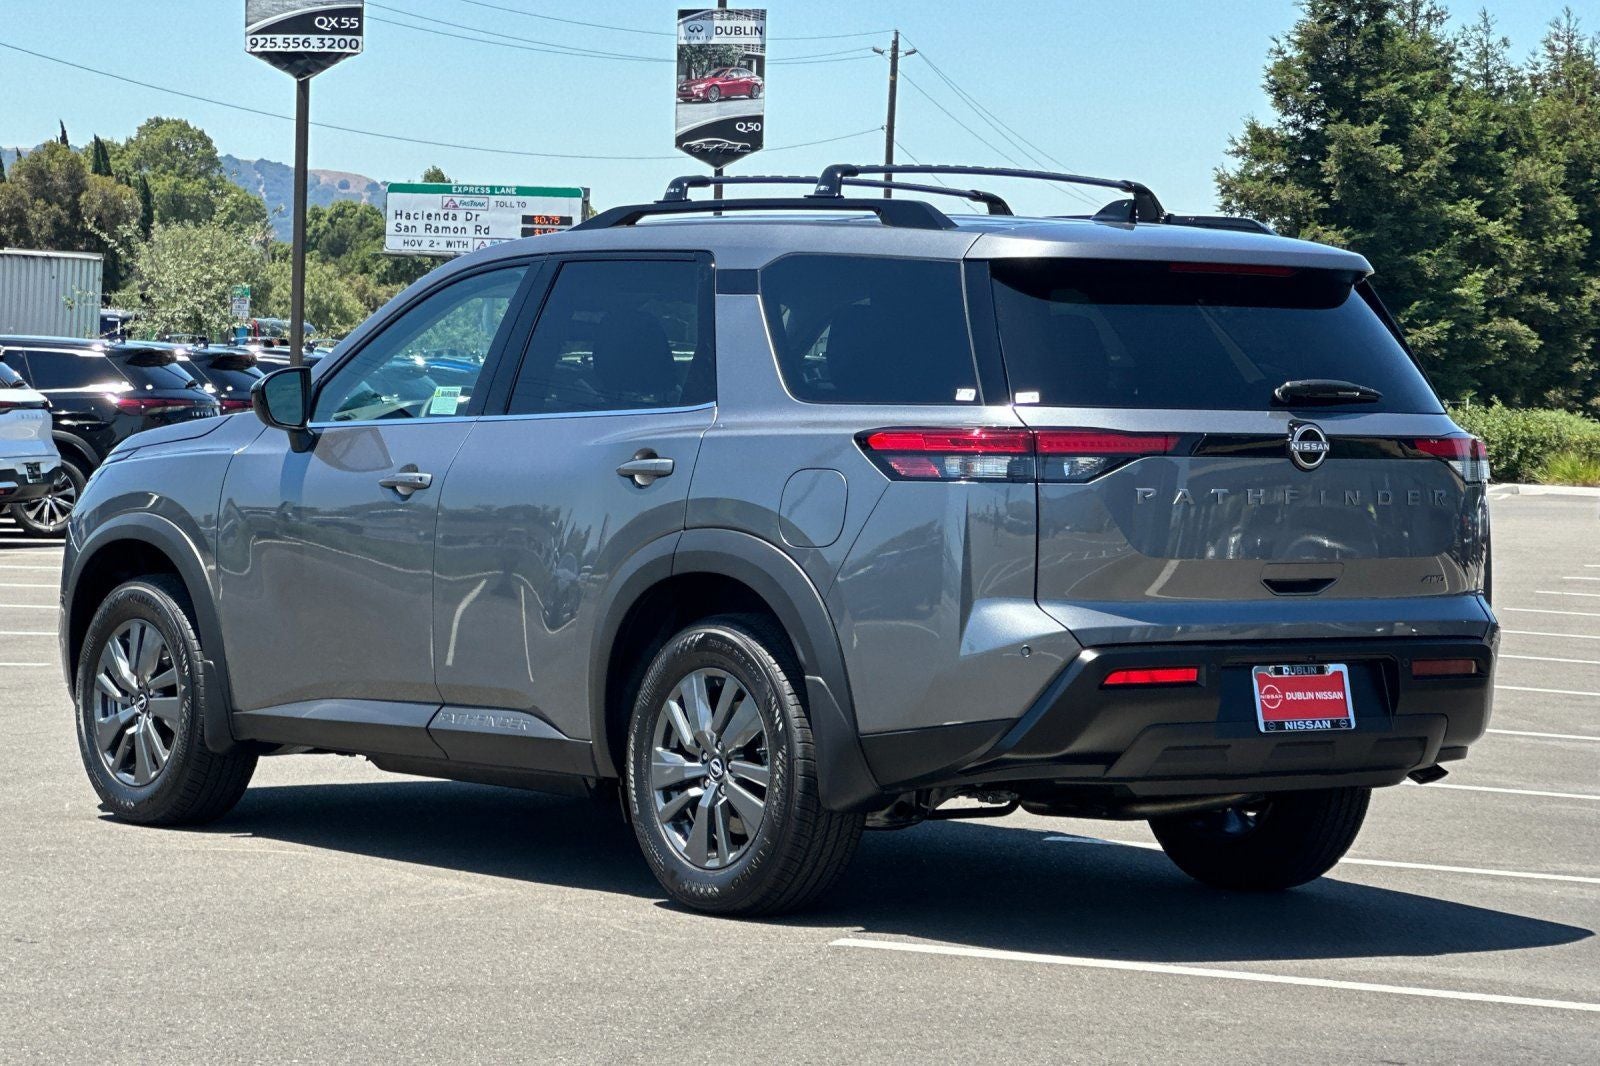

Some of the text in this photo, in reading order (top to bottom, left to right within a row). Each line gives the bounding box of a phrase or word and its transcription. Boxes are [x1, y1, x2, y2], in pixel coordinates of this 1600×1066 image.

[314, 16, 360, 30] QX55
[714, 26, 763, 36] DUBLIN
[249, 37, 360, 49] 925.556.3200
[735, 122, 762, 133] Q50
[451, 185, 517, 195] EXPRESS LANE
[394, 210, 480, 221] Hacienda Dr
[534, 215, 560, 224] $0.75
[394, 223, 490, 235] San Ramon Rd
[403, 239, 423, 247] HOV
[446, 240, 469, 249] WITH
[1291, 442, 1330, 451] NISSAN
[1135, 487, 1448, 506] PATHFINDER
[1282, 665, 1317, 676] DUBLIN
[1285, 691, 1344, 701] DUBLIN NISSAN
[1284, 719, 1332, 730] NISSAN
